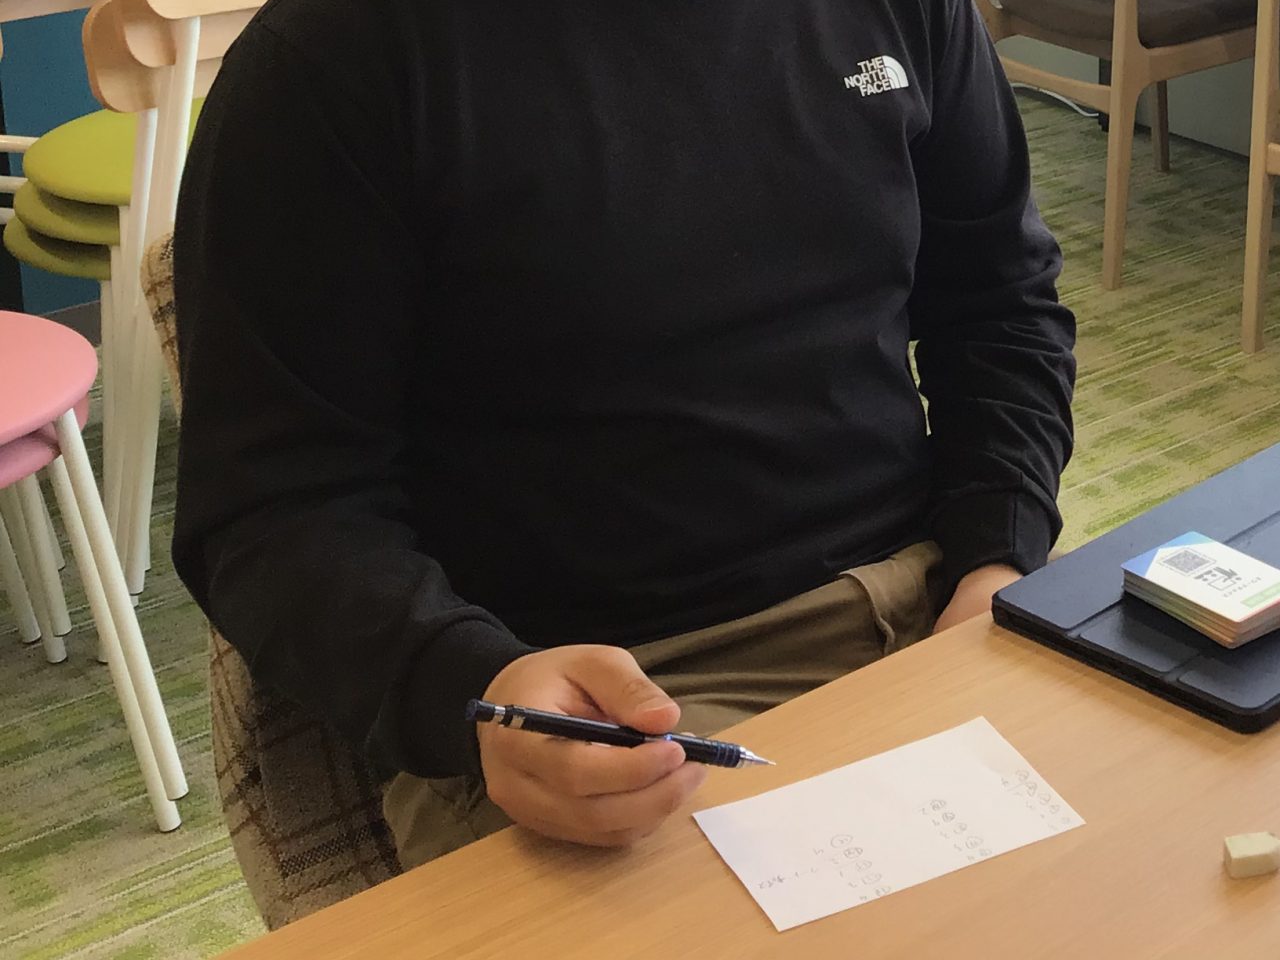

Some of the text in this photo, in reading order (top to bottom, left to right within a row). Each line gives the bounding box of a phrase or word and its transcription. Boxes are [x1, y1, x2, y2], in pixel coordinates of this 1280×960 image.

[857, 56, 884, 73] THE
[843, 67, 888, 89] NORTH
[859, 78, 891, 97] FACE
